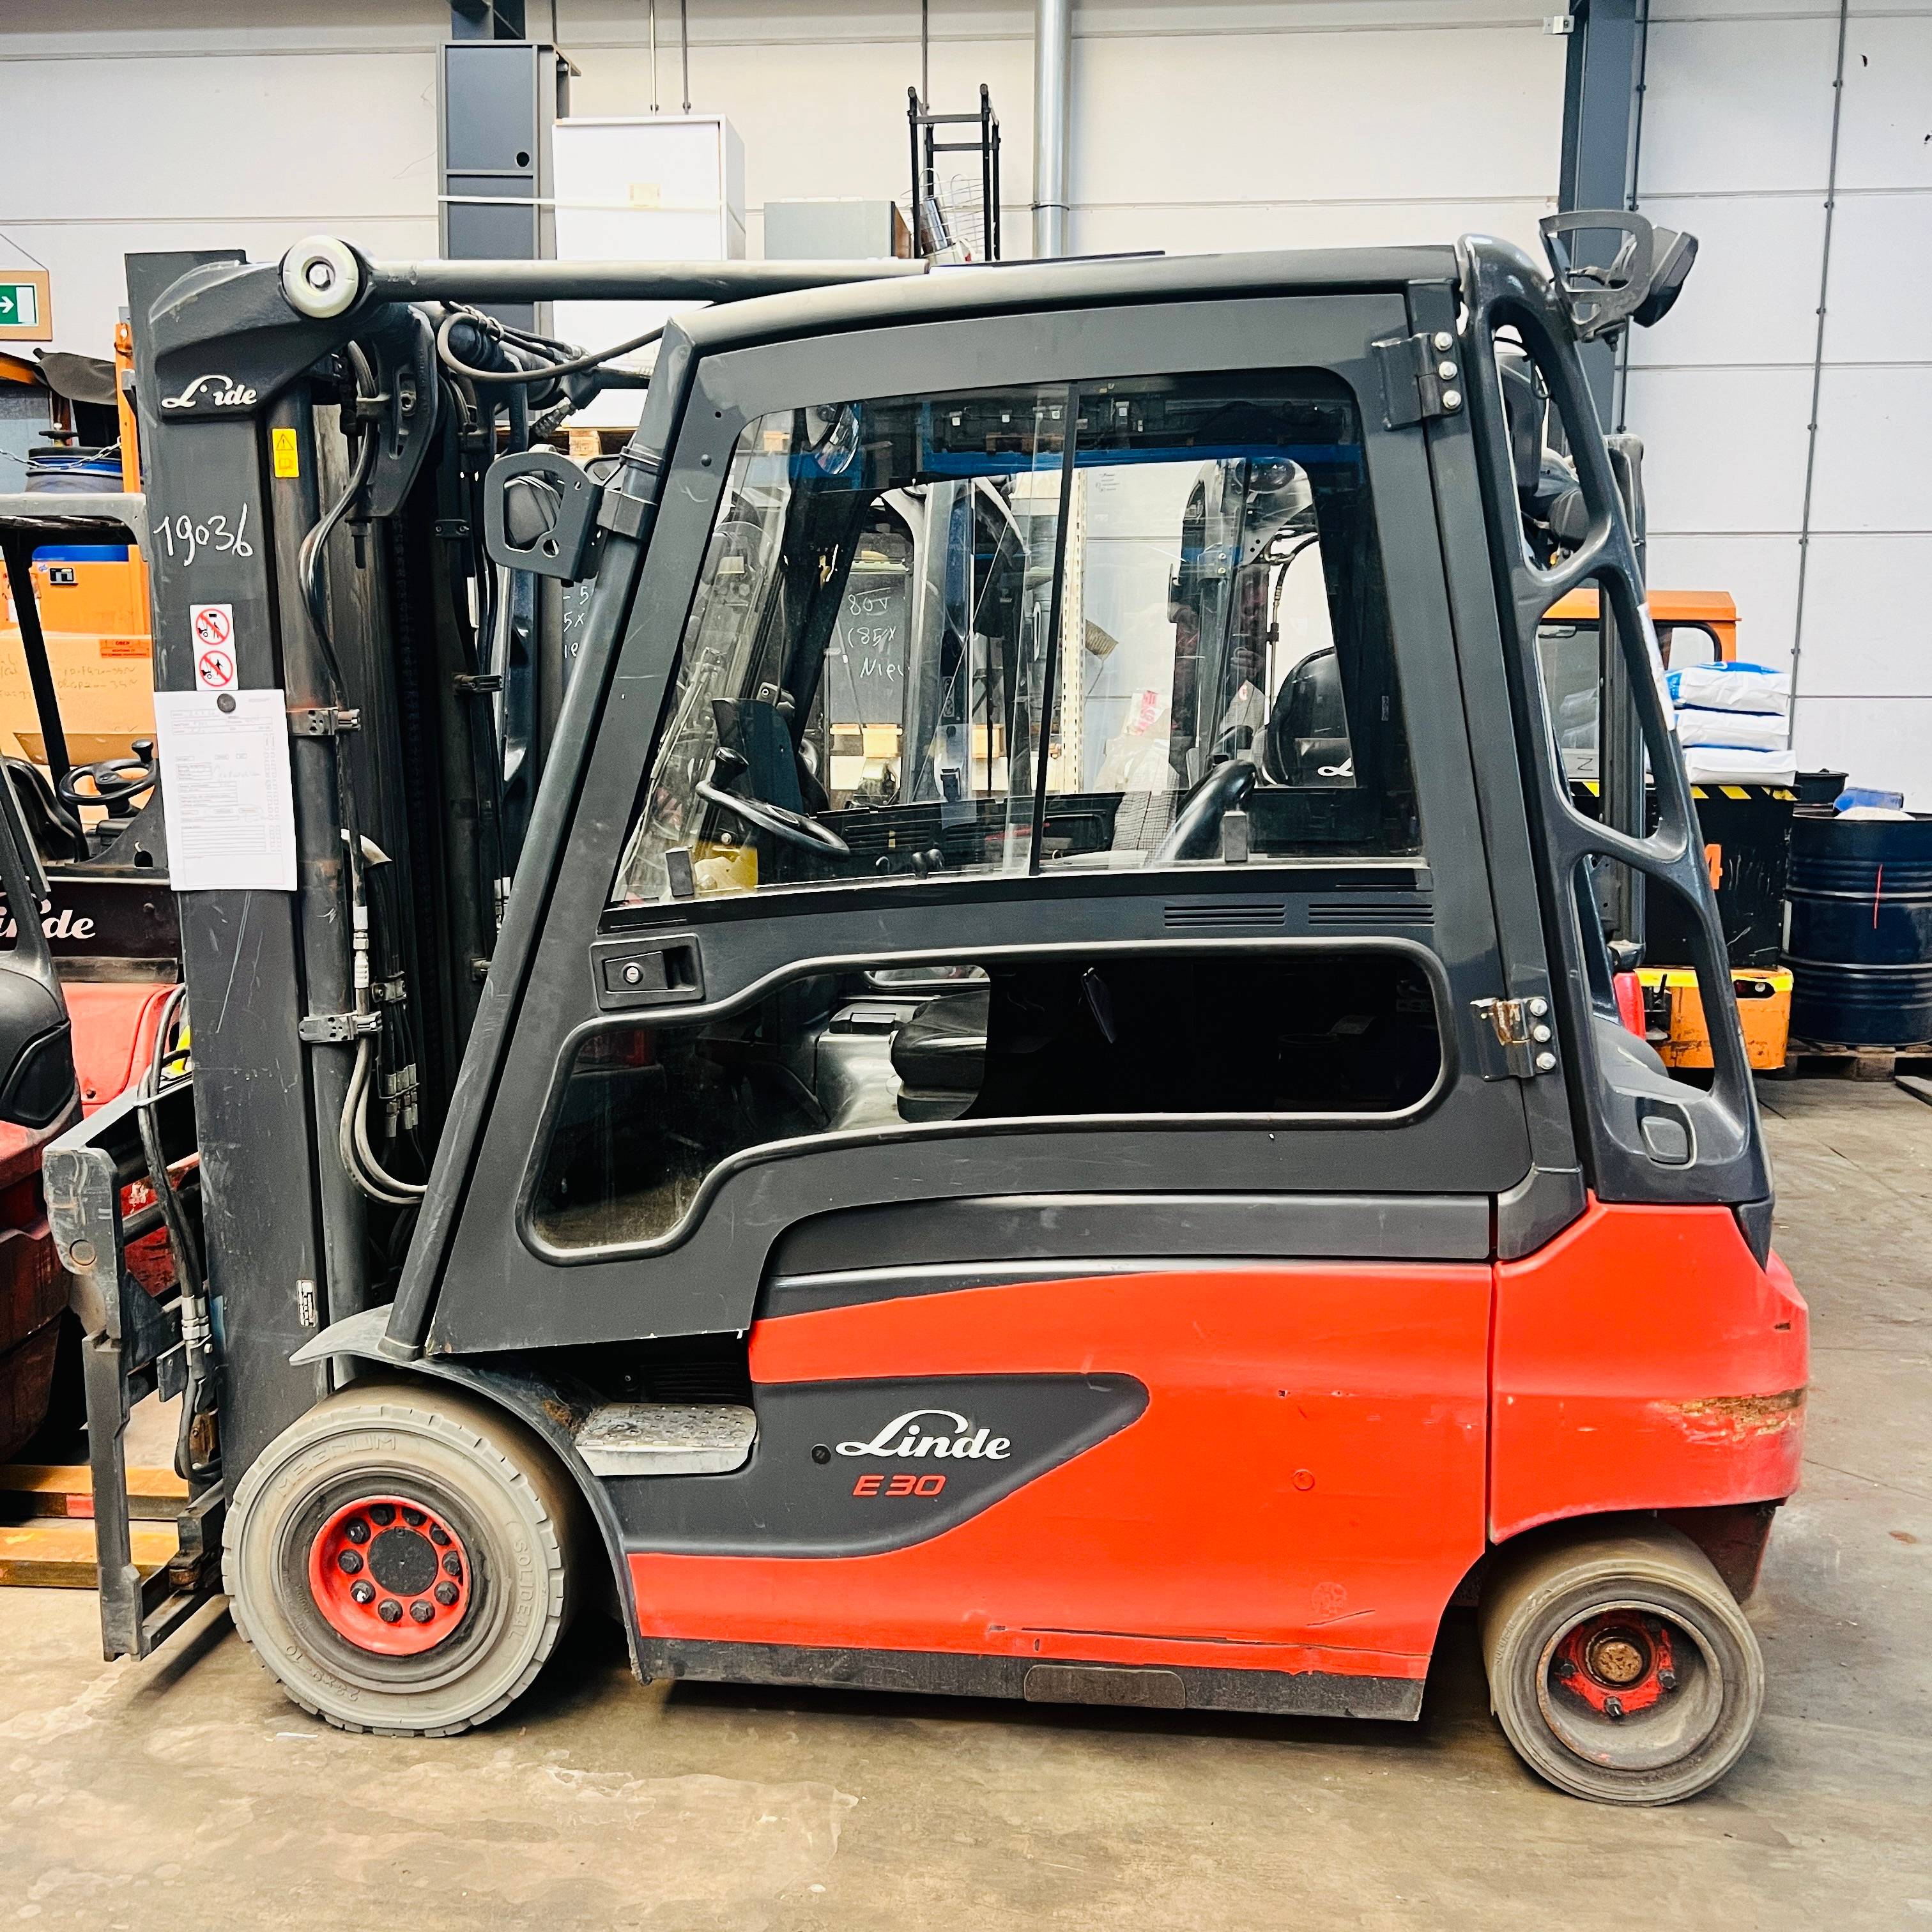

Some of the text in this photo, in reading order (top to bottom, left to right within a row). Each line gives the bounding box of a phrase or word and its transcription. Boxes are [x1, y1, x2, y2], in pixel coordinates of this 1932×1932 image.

[153, 502, 254, 567] 19036
[835, 1409, 1011, 1460] Linde
[852, 1475, 947, 1497] E 30
